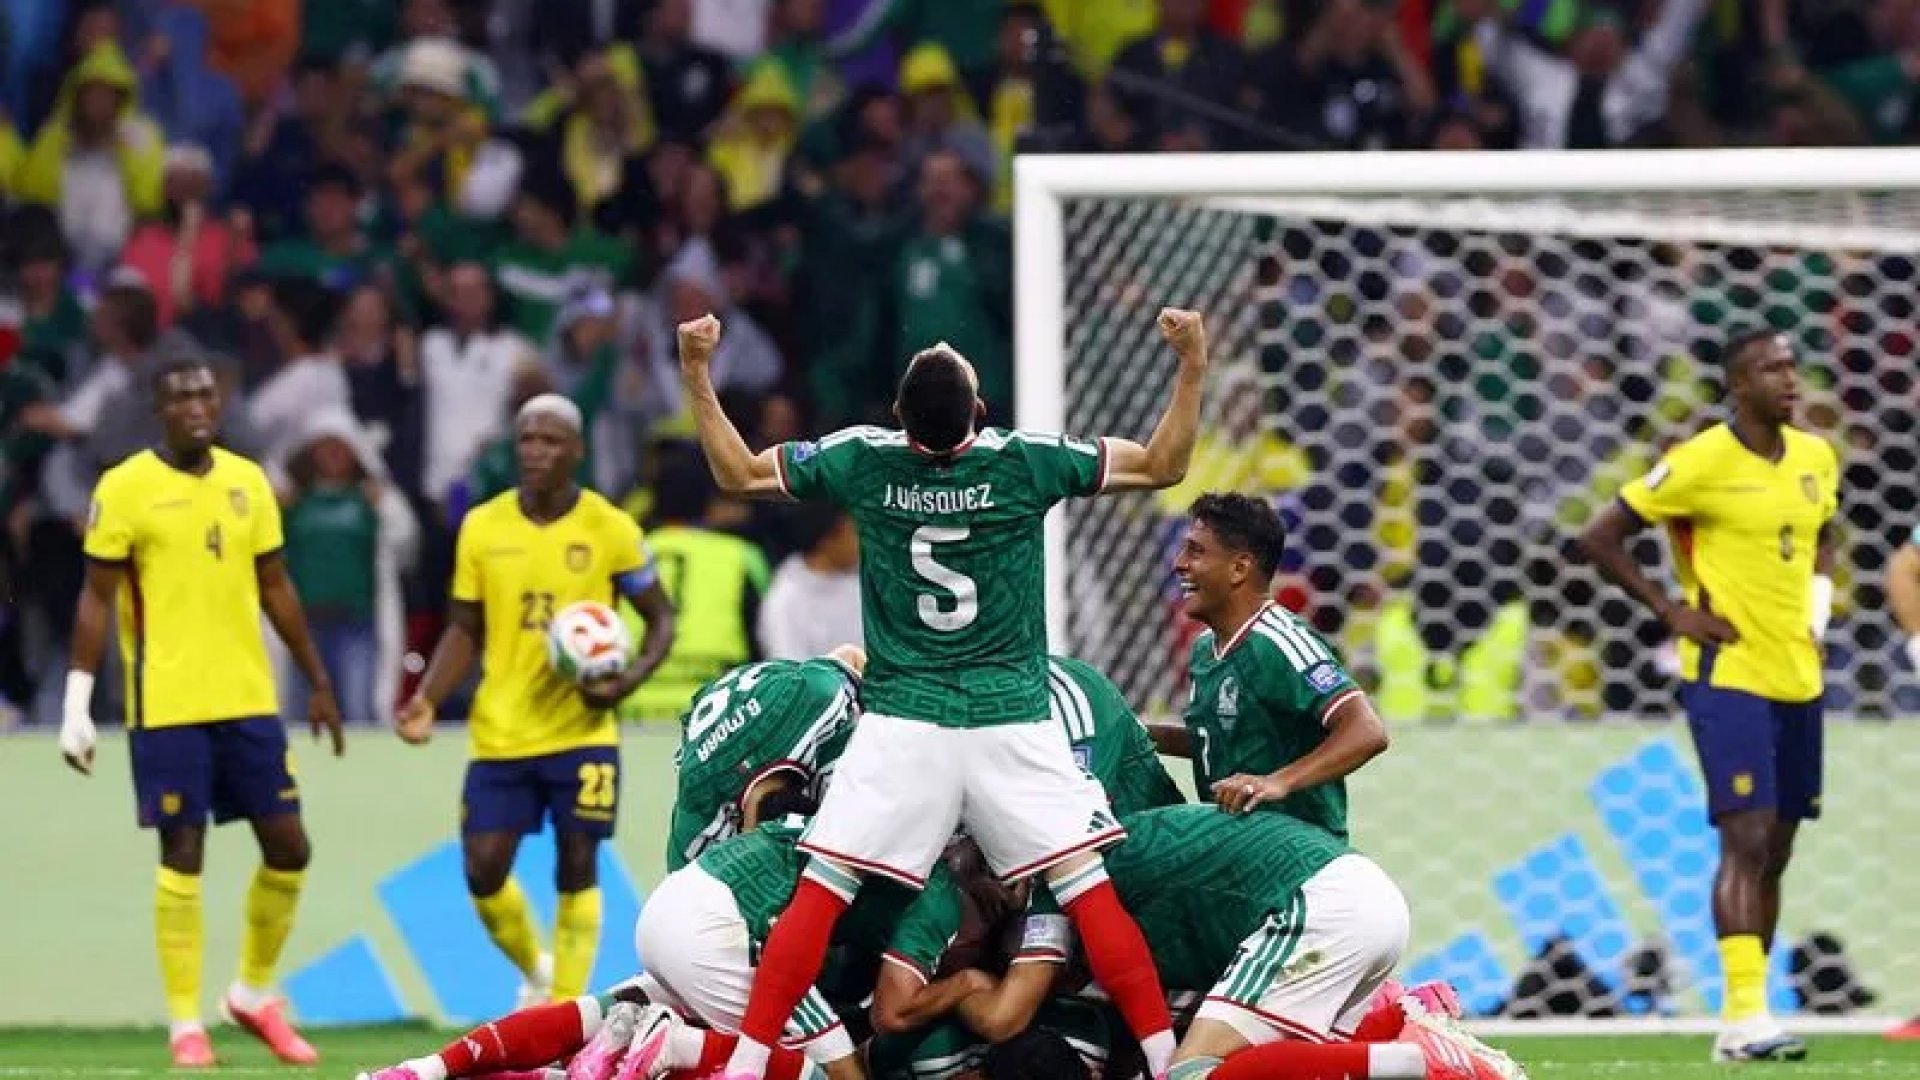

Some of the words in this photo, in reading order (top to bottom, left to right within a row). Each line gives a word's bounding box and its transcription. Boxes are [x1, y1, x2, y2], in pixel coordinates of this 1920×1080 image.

[204, 520, 222, 563] 4
[910, 525, 977, 631] 5
[520, 590, 555, 630] 23
[577, 762, 616, 808] 23
